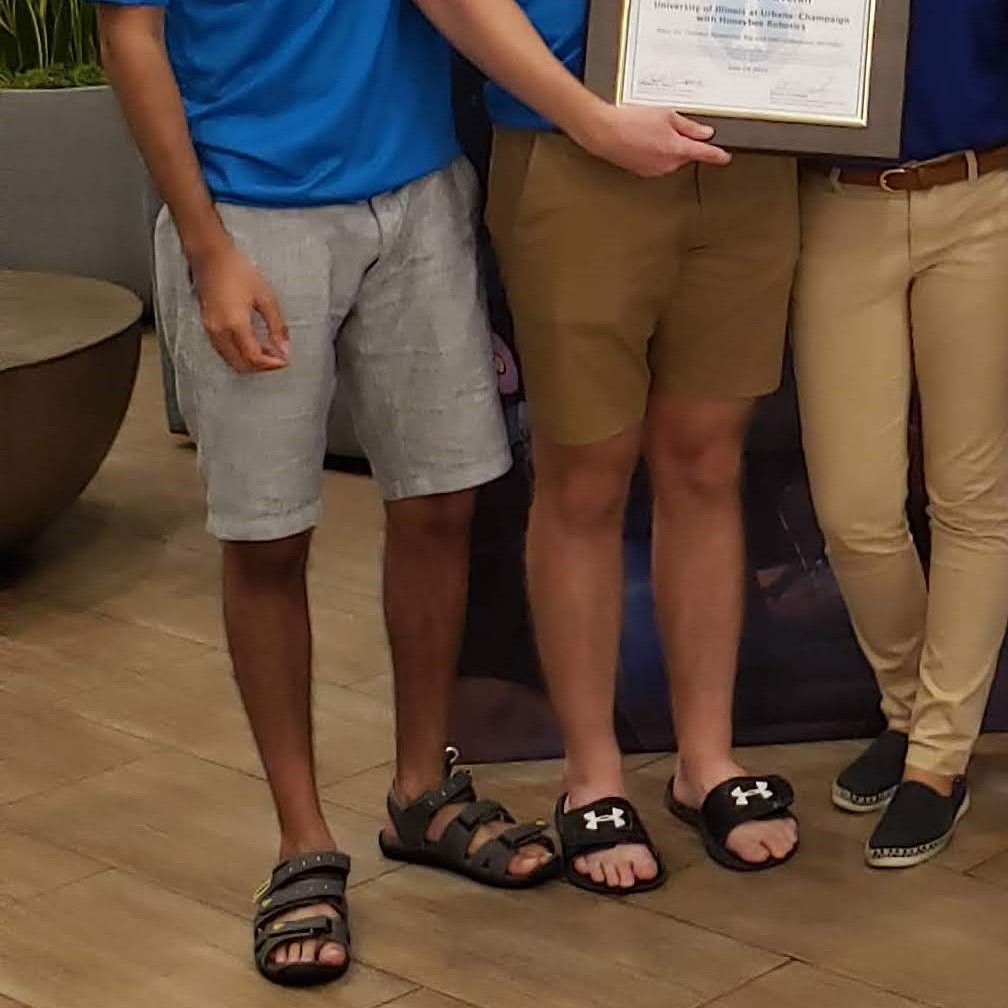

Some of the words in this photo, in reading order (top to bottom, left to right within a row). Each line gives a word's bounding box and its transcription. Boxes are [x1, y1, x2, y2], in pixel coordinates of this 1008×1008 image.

[654, 0, 700, 13] University
[703, 4, 713, 12] of
[715, 5, 745, 16] Illinois
[749, 8, 758, 16] at
[696, 15, 717, 24] with
[767, 20, 806, 31] Robotics
